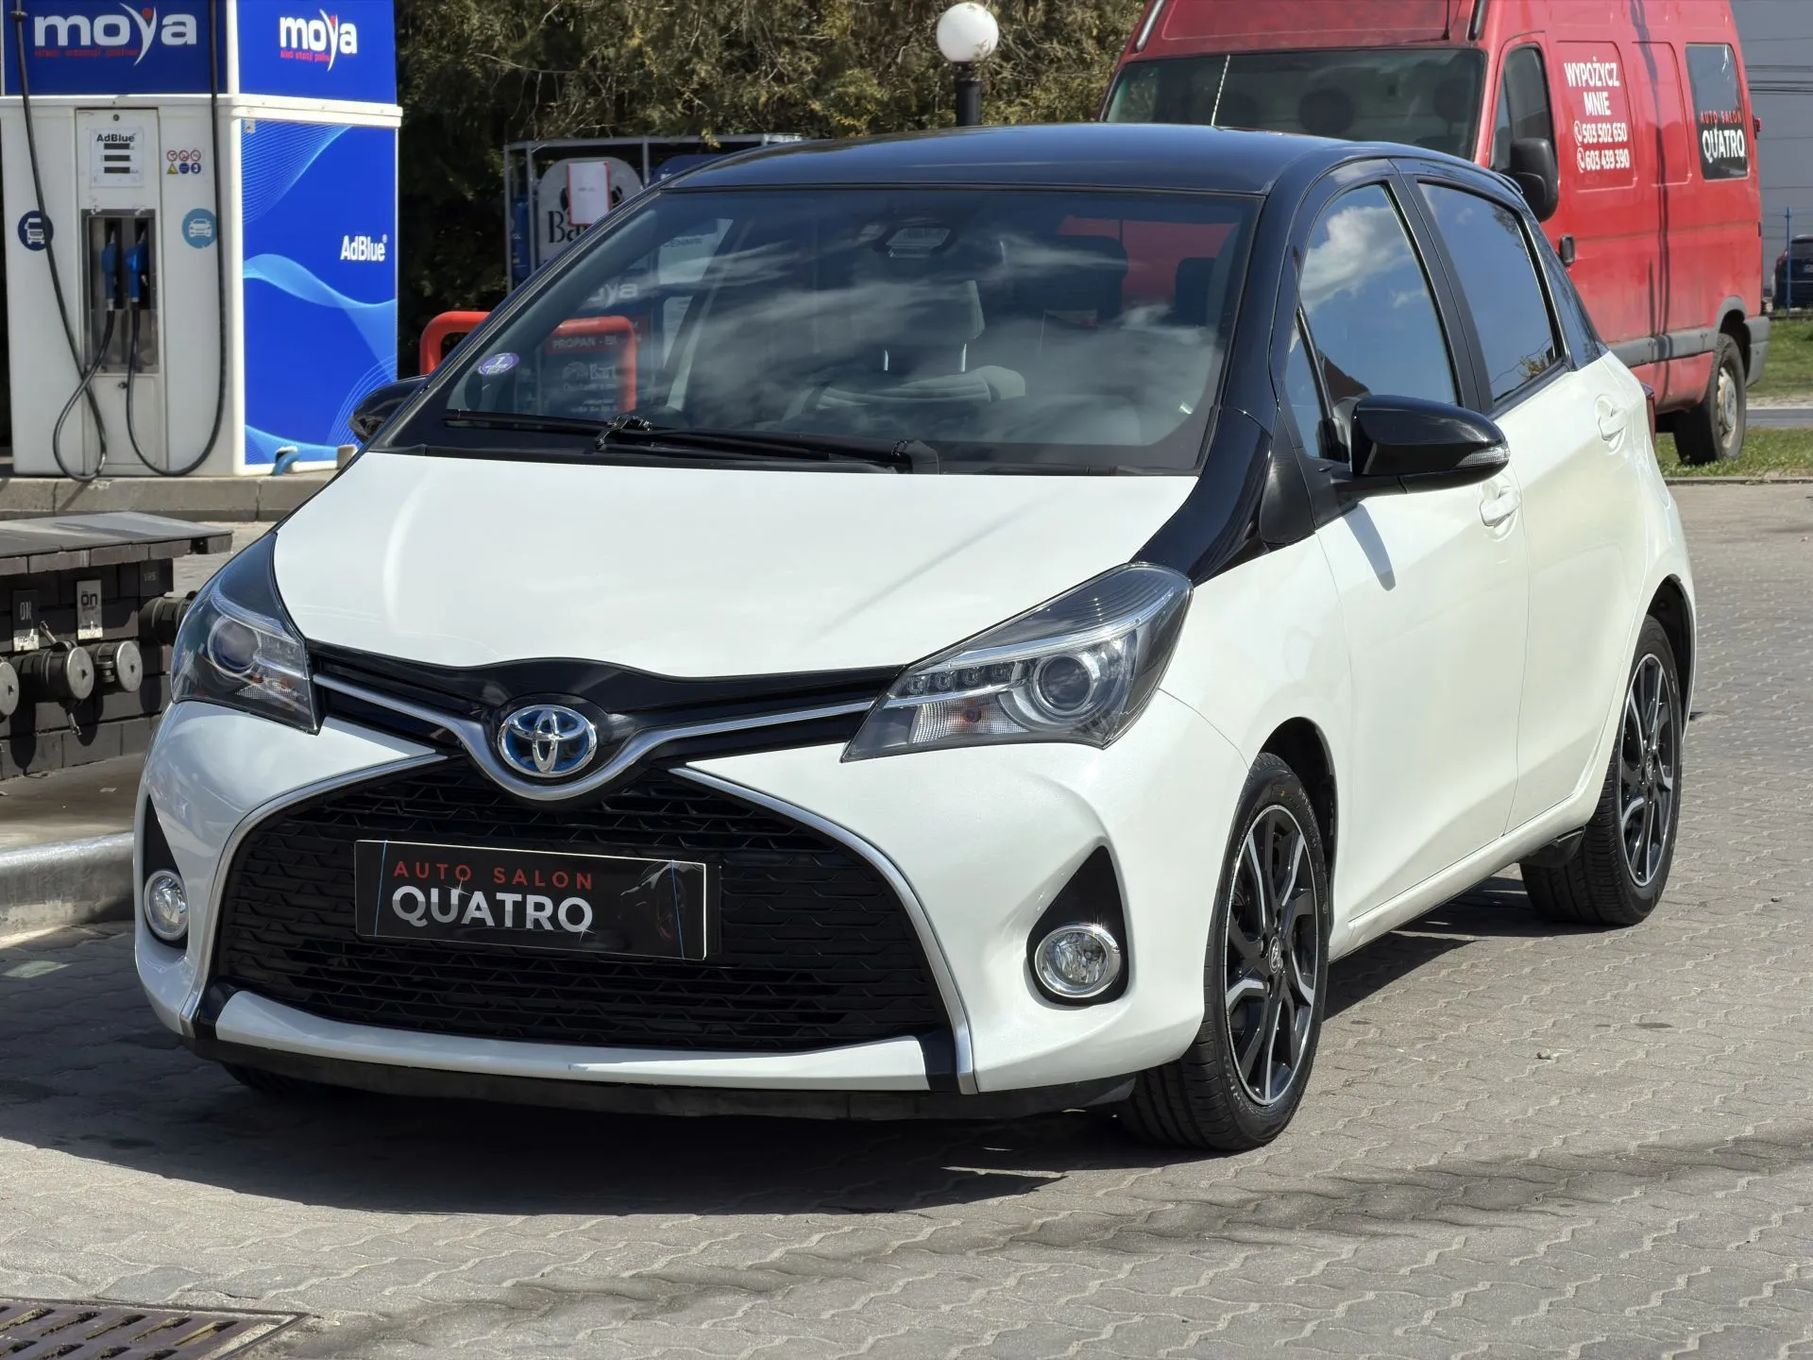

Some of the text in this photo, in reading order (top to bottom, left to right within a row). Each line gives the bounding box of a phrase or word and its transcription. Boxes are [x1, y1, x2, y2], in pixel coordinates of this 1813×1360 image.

[34, 2, 198, 66] moya
[279, 8, 357, 71] moya
[1564, 56, 1620, 87] WYPOŻYCZ
[1583, 91, 1611, 116] MNIE
[1582, 123, 1598, 144] 503
[1598, 123, 1612, 143] 502
[1702, 128, 1745, 163] QUATRO
[393, 861, 592, 890] AUTO SALON
[392, 885, 593, 933] QUATRO
